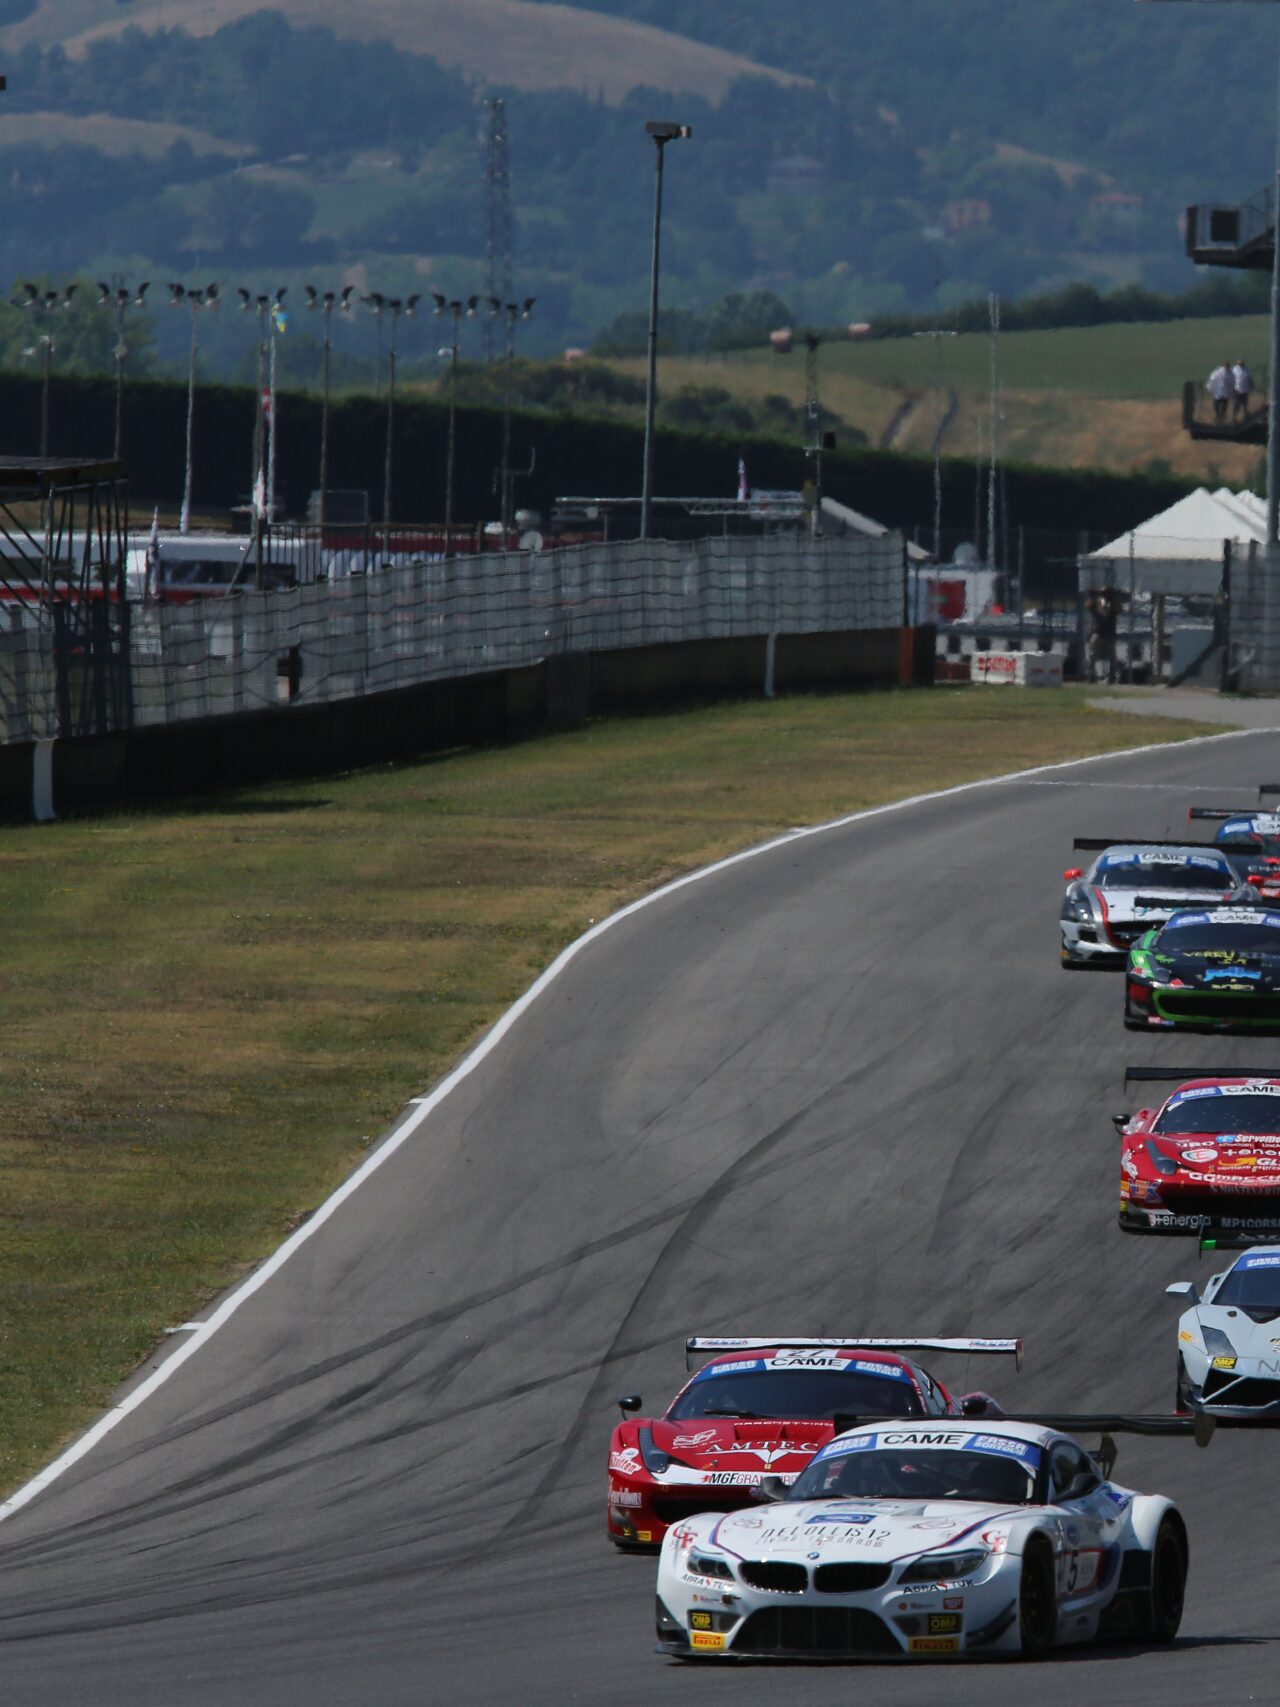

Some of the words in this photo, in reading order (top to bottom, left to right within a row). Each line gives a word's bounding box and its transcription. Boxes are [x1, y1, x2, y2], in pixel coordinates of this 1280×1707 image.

[770, 1358, 842, 1367] CAME
[1213, 1359, 1235, 1367] OMP
[883, 1434, 964, 1445] CAME
[1066, 1548, 1079, 1593] 5
[691, 1614, 712, 1627] OMP
[930, 1618, 958, 1629] OMP
